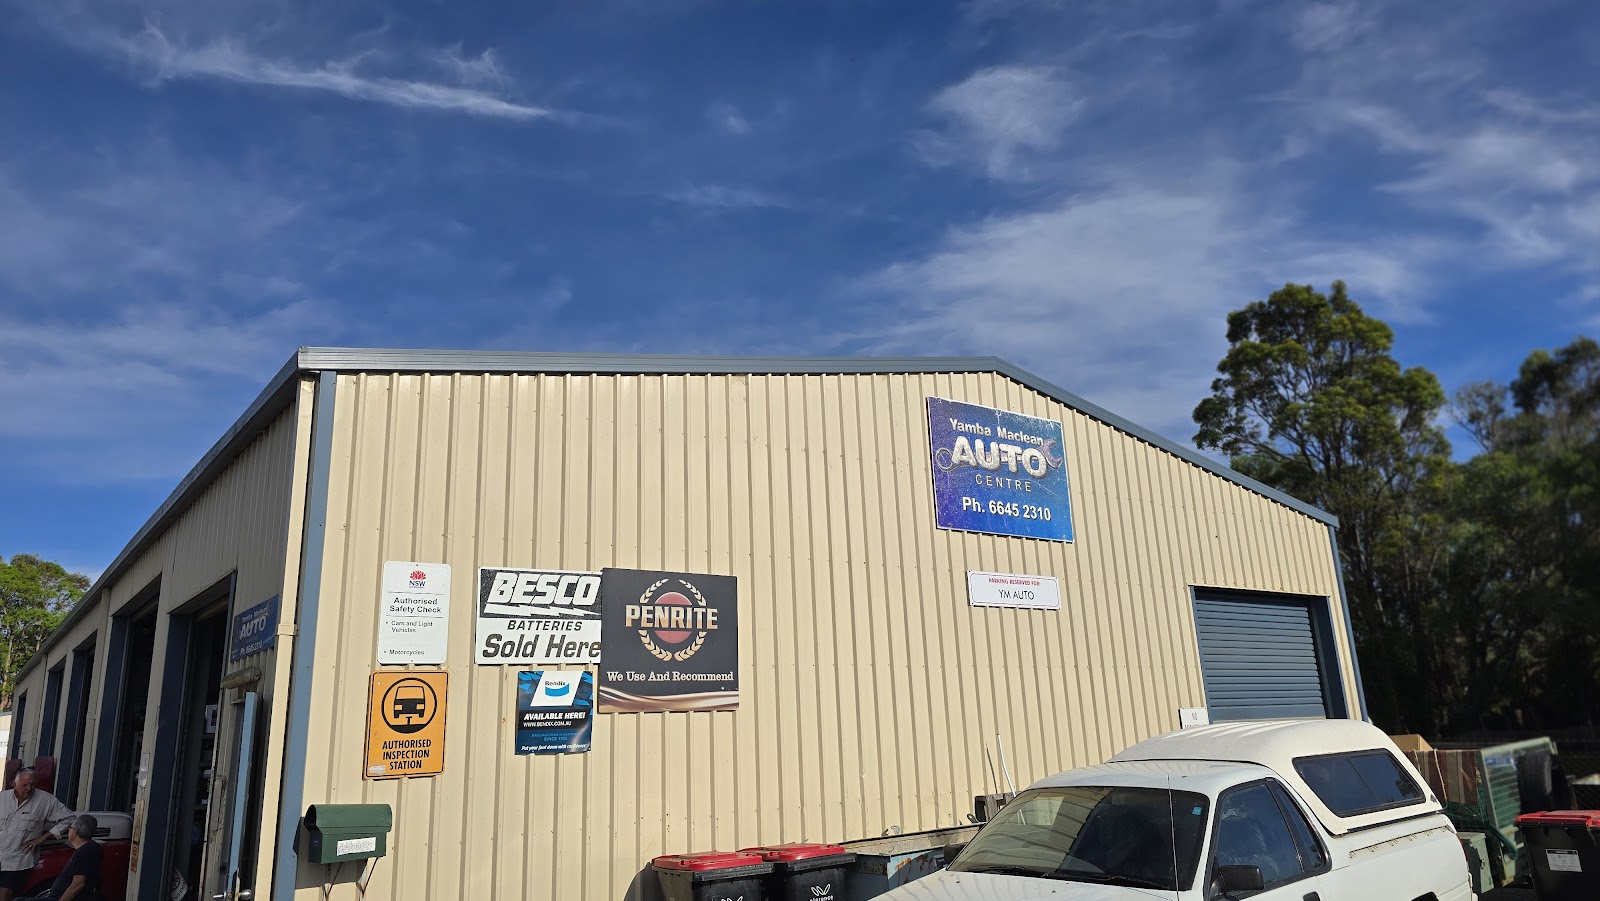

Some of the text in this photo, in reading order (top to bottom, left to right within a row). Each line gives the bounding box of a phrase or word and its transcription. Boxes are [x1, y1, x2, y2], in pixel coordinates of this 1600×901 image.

[949, 417, 1044, 446] Yamba Maclean
[951, 435, 1048, 479] AUTO
[975, 473, 1032, 492] CENTRE
[962, 496, 1051, 521] Ph. 6645 2310
[487, 572, 601, 606] BESCO
[999, 589, 1035, 600] YM AUTO
[393, 597, 438, 605] Authorised
[389, 605, 442, 614] Safety Check
[625, 604, 718, 630] PENRITE
[240, 616, 266, 640] AUTO
[507, 619, 583, 632] BATTERIES
[482, 633, 600, 659] Sold Here
[607, 671, 734, 682] We Use And Recommend
[544, 679, 566, 687] Bendix
[524, 712, 563, 720] AVAILABLE
[382, 738, 432, 750] AUTHORISED
[382, 749, 430, 761] INSPECTION
[389, 759, 422, 771] STATION
